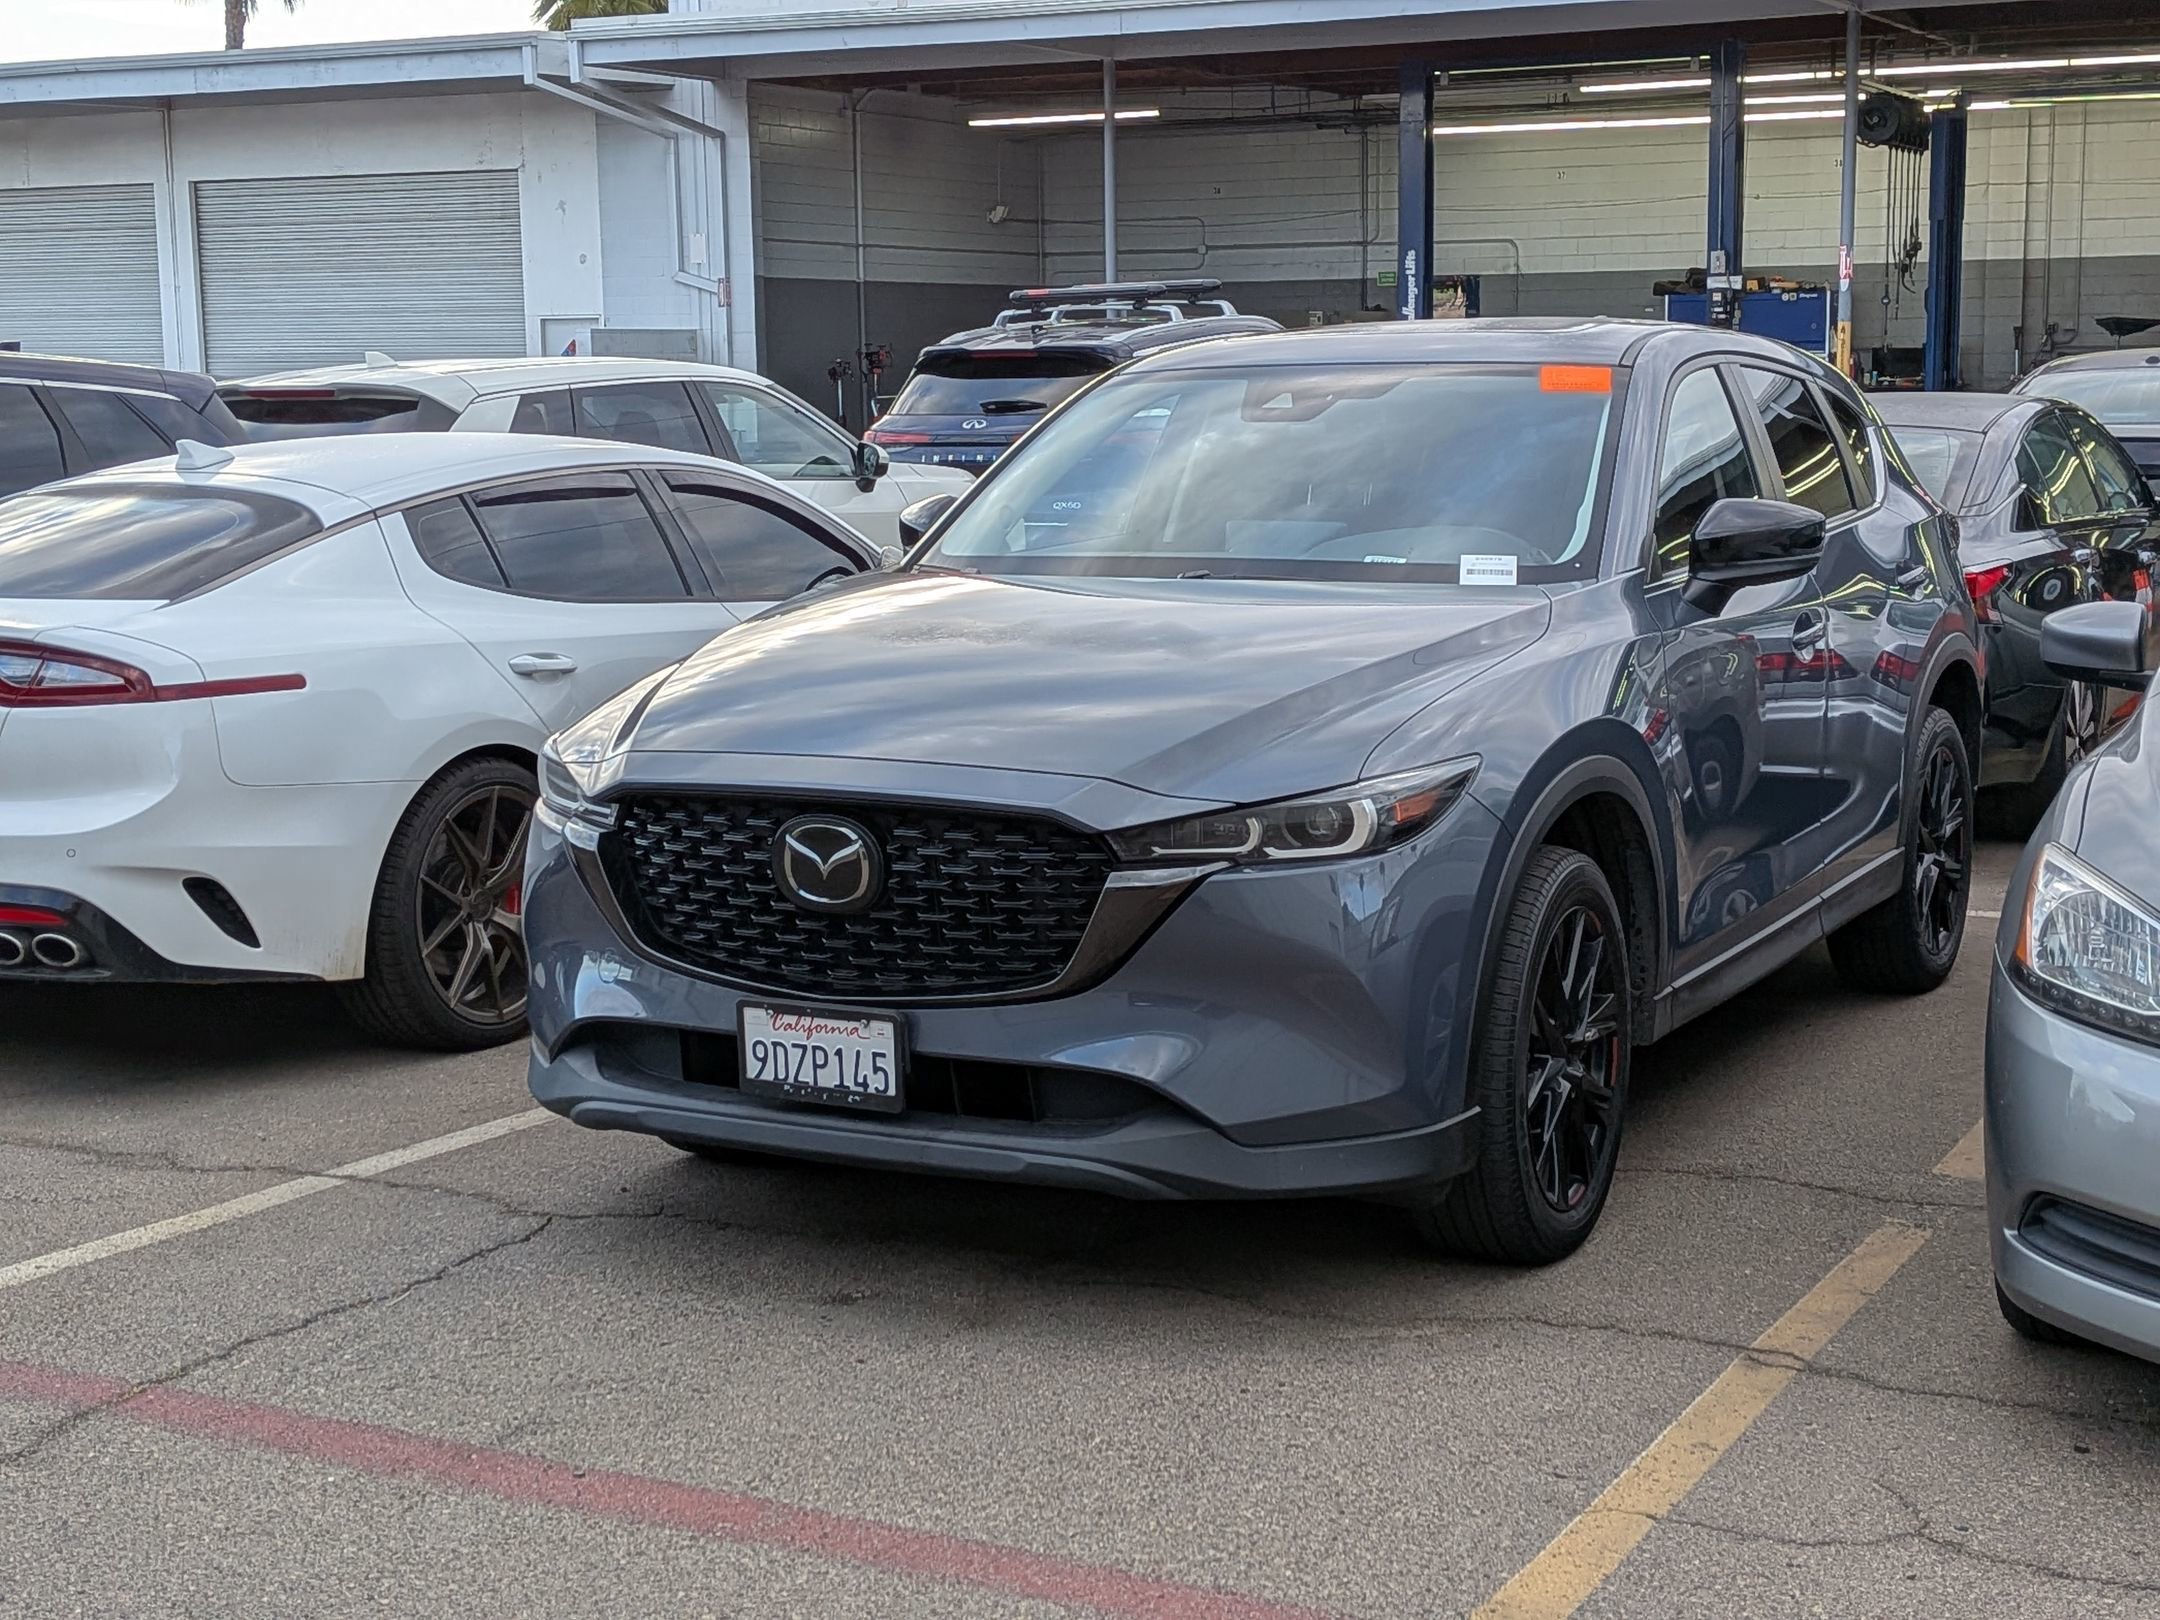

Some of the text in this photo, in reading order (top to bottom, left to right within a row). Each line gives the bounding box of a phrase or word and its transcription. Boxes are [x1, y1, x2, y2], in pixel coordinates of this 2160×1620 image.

[1402, 249, 1418, 320] allenger Lifts
[921, 454, 998, 463] INFINI
[1053, 501, 1081, 510] QX60
[771, 1012, 871, 1041] California
[752, 1039, 890, 1095] 9DZP145
